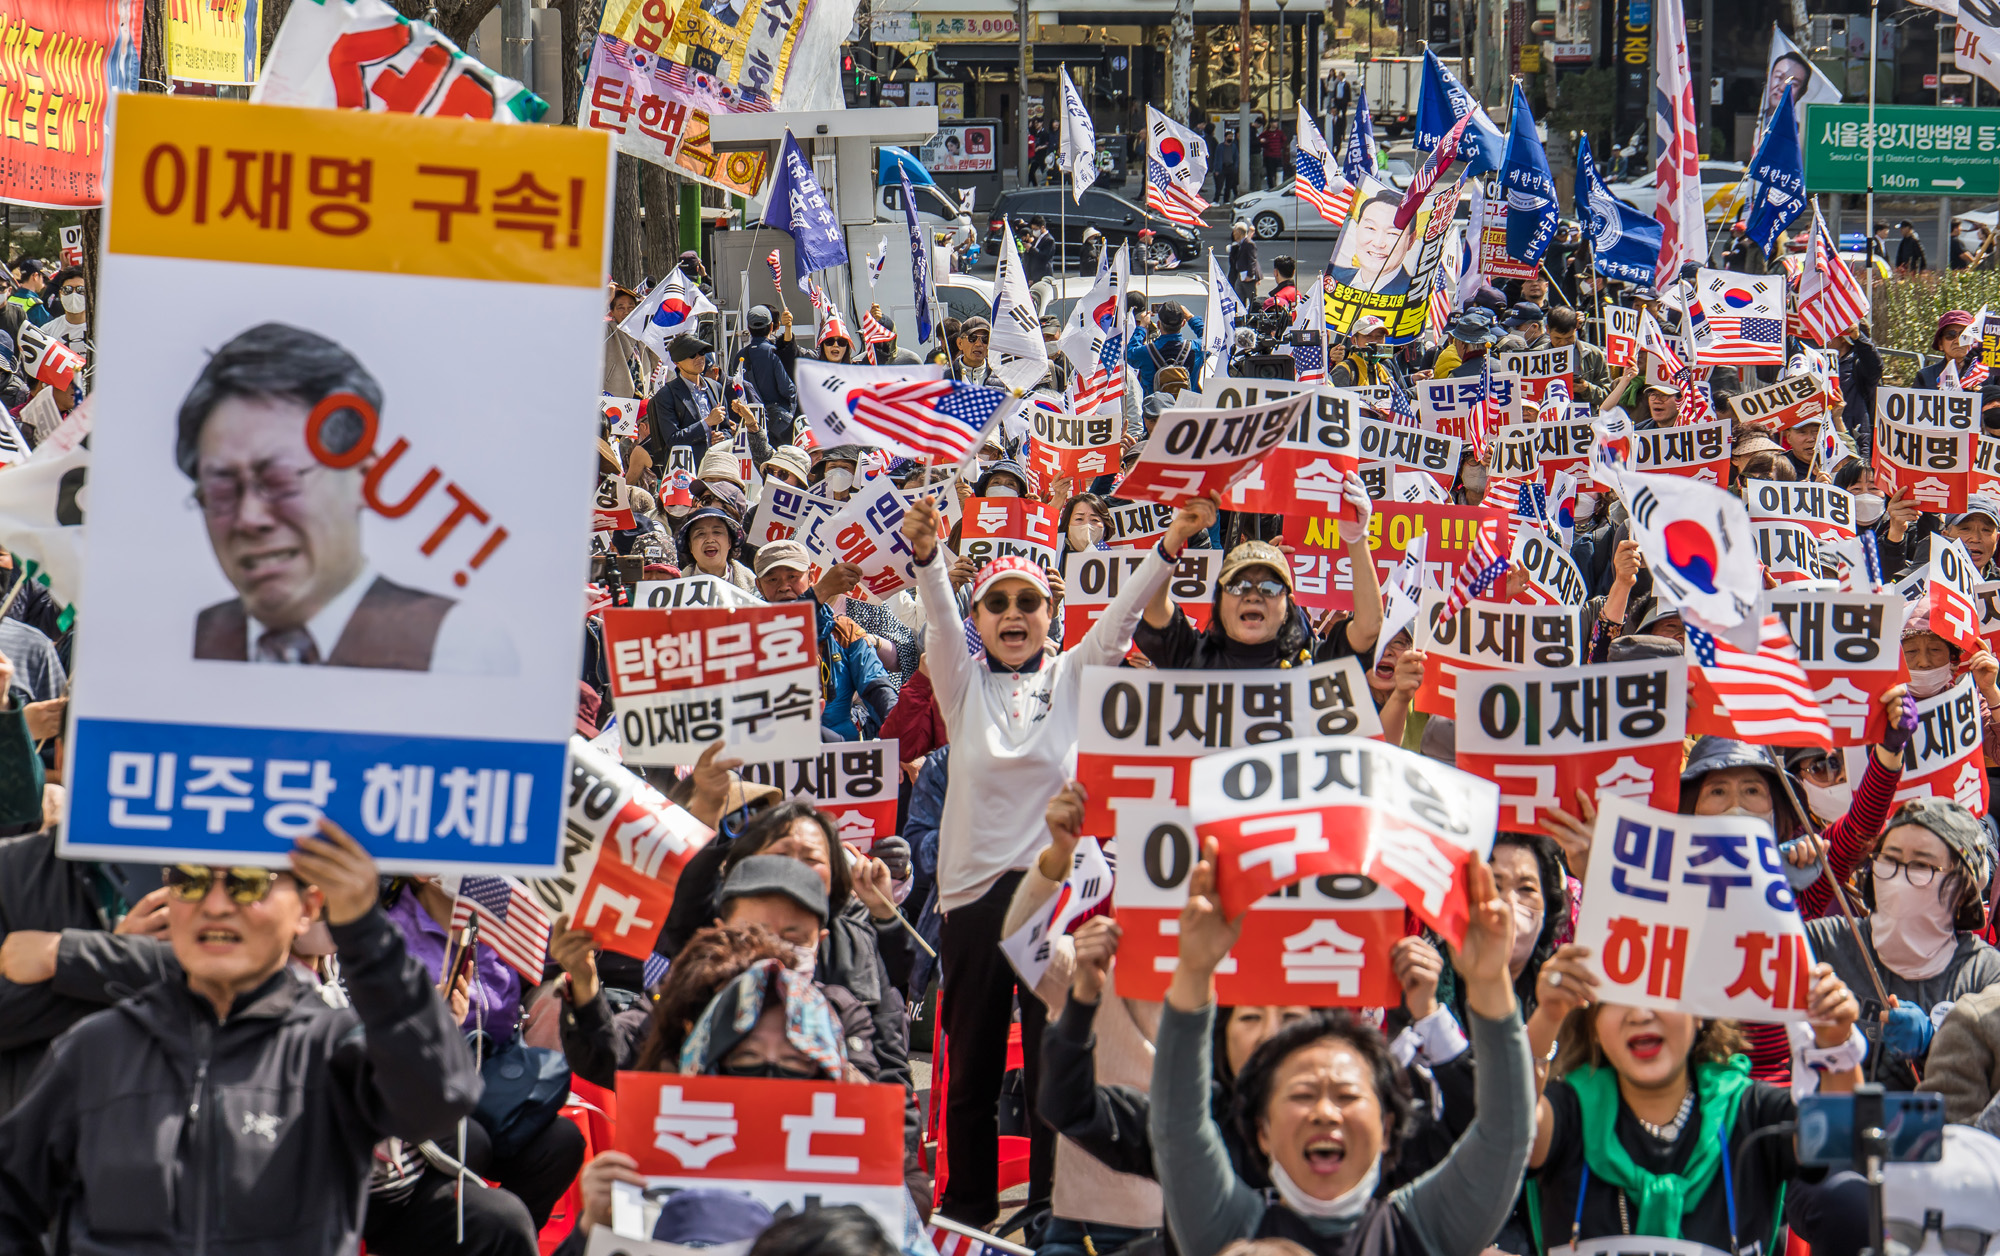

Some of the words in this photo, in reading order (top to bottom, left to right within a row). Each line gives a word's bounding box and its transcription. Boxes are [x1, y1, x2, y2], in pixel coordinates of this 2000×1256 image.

[936, 18, 966, 34] 소주
[589, 75, 687, 156] 탄핵
[1821, 121, 1971, 150] 서울중앙지방법원
[1829, 152, 1852, 162] Seoul
[1853, 153, 1884, 163] Cenral
[1885, 154, 1915, 163] District
[1917, 155, 1940, 164] Court
[1942, 156, 1991, 166] Registration
[1881, 174, 1919, 188] 140m
[141, 143, 374, 237] 이재명
[411, 163, 586, 250] 구속!
[1493, 265, 1536, 277] Impeachment!
[1613, 340, 1630, 363] 구
[1984, 324, 2000, 336] 이재
[1507, 351, 1569, 377] 이재명
[1741, 375, 1817, 416] 이재명
[1886, 393, 1973, 430] 이재명
[1033, 411, 1113, 446] 이재명
[1164, 401, 1300, 459] 이재명
[1360, 425, 1452, 470] 이재명
[1637, 425, 1723, 466] 이재명
[1878, 417, 1959, 470] 이재명
[1038, 450, 1107, 476] 구속
[305, 392, 510, 587] OUT!
[1758, 485, 1850, 526] 이재명
[1880, 476, 1950, 509] 구속
[835, 521, 906, 596] 해체
[613, 614, 808, 693] 탄핵무효
[1429, 600, 1575, 668] 이재명
[623, 698, 723, 747] 이재명
[731, 684, 816, 735] 구속
[1101, 681, 1294, 748] 이재명
[1478, 670, 1668, 746] 이재명
[107, 750, 338, 840] 민주당
[359, 762, 535, 845] 해체!
[1494, 755, 1654, 825] 구속
[1238, 812, 1457, 918] 구속
[1602, 914, 1809, 1010] 해체
